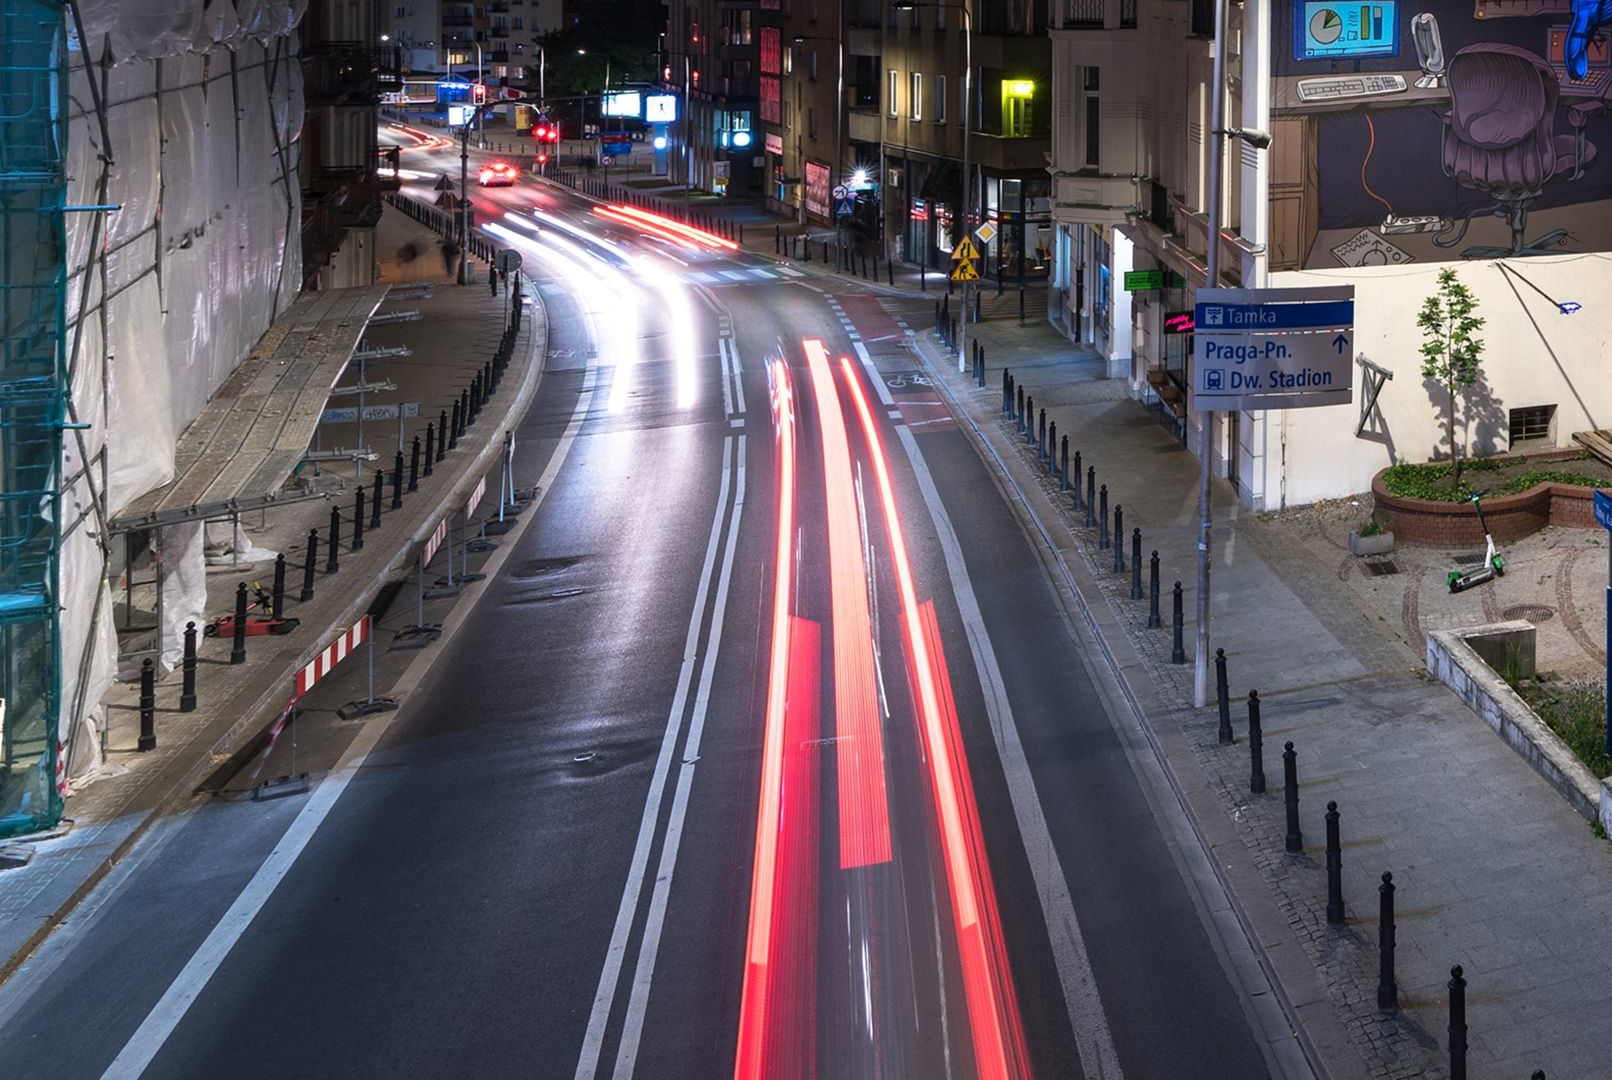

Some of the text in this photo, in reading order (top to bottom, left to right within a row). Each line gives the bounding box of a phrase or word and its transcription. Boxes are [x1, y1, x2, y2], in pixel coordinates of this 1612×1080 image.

[1227, 307, 1277, 324] Tamka
[1205, 341, 1292, 364] Praga-Pn.
[1230, 368, 1332, 389] Dw. Stadion
